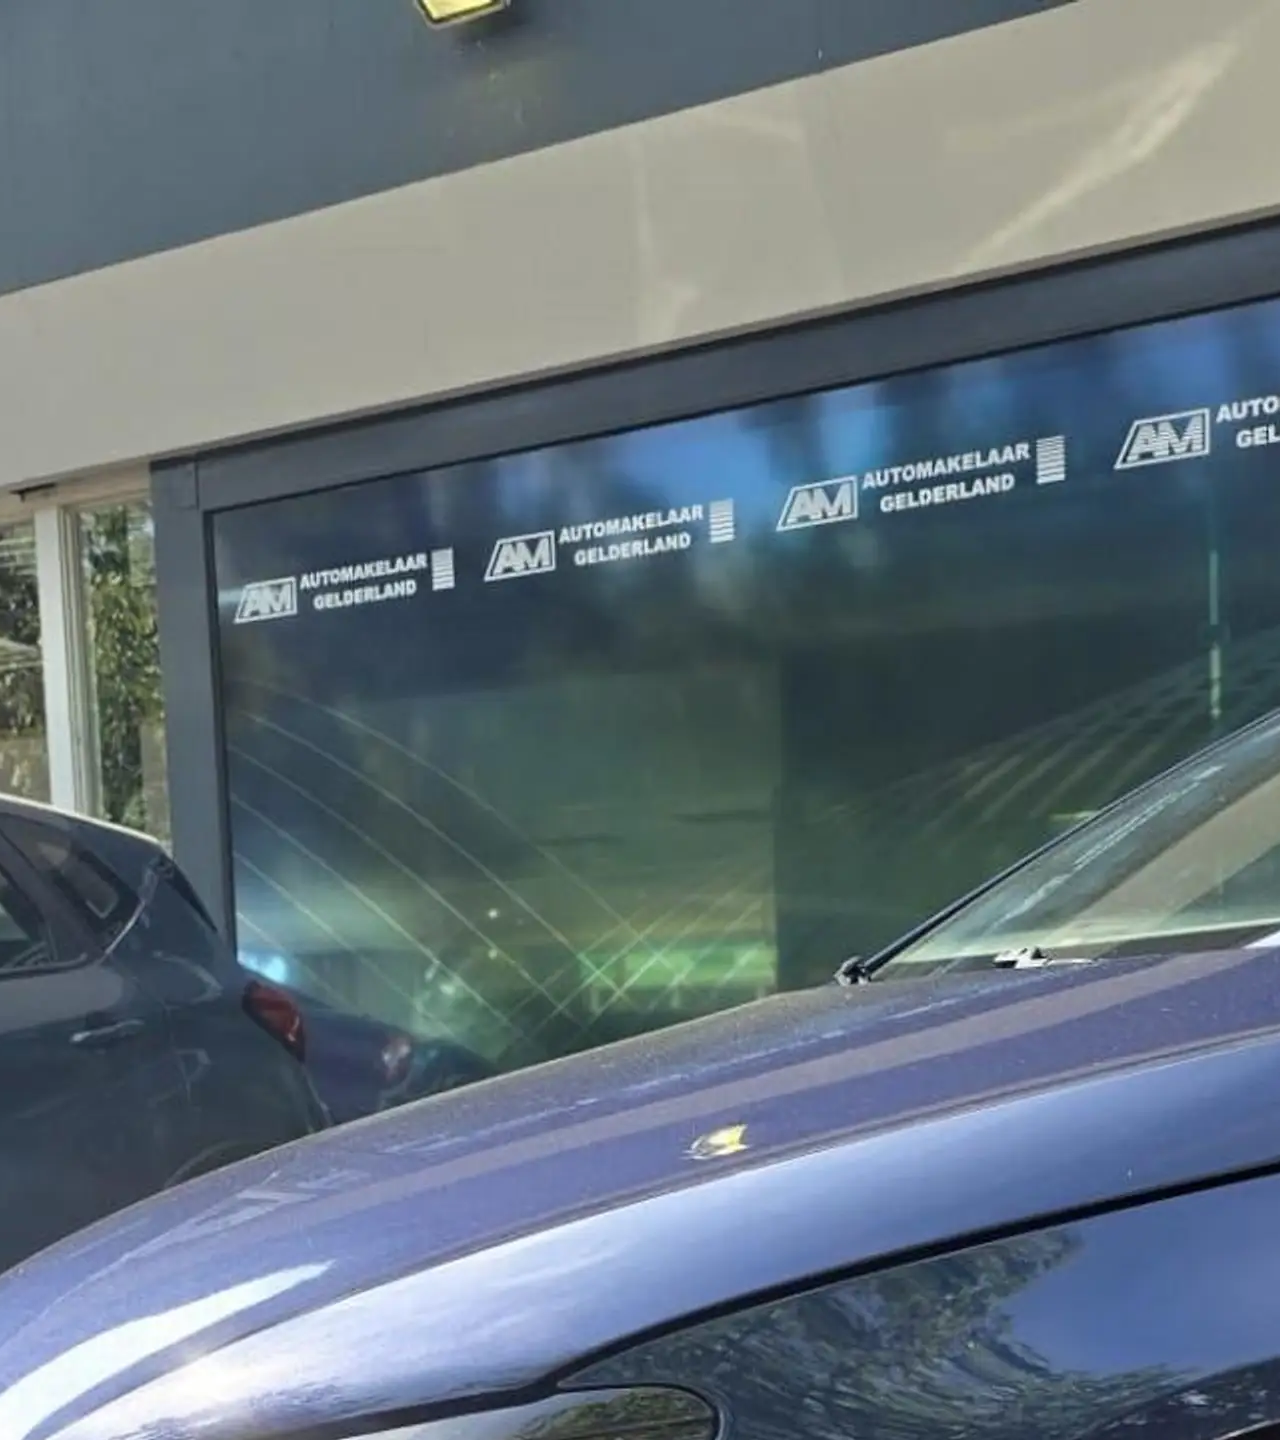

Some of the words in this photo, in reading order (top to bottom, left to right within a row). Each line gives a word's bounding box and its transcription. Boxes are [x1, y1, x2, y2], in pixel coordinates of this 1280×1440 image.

[1123, 413, 1207, 464] AM
[862, 442, 1031, 490] AUTOMAKELAAR
[784, 480, 855, 526] AM
[879, 472, 1016, 513] GELDERLAND
[558, 504, 704, 545] AUTOMAKELAAR
[490, 535, 553, 577] AM
[573, 531, 692, 567] GELDERLAND
[299, 553, 428, 590] AUTOMAKELAAR
[312, 579, 418, 610] GELDERLAND
